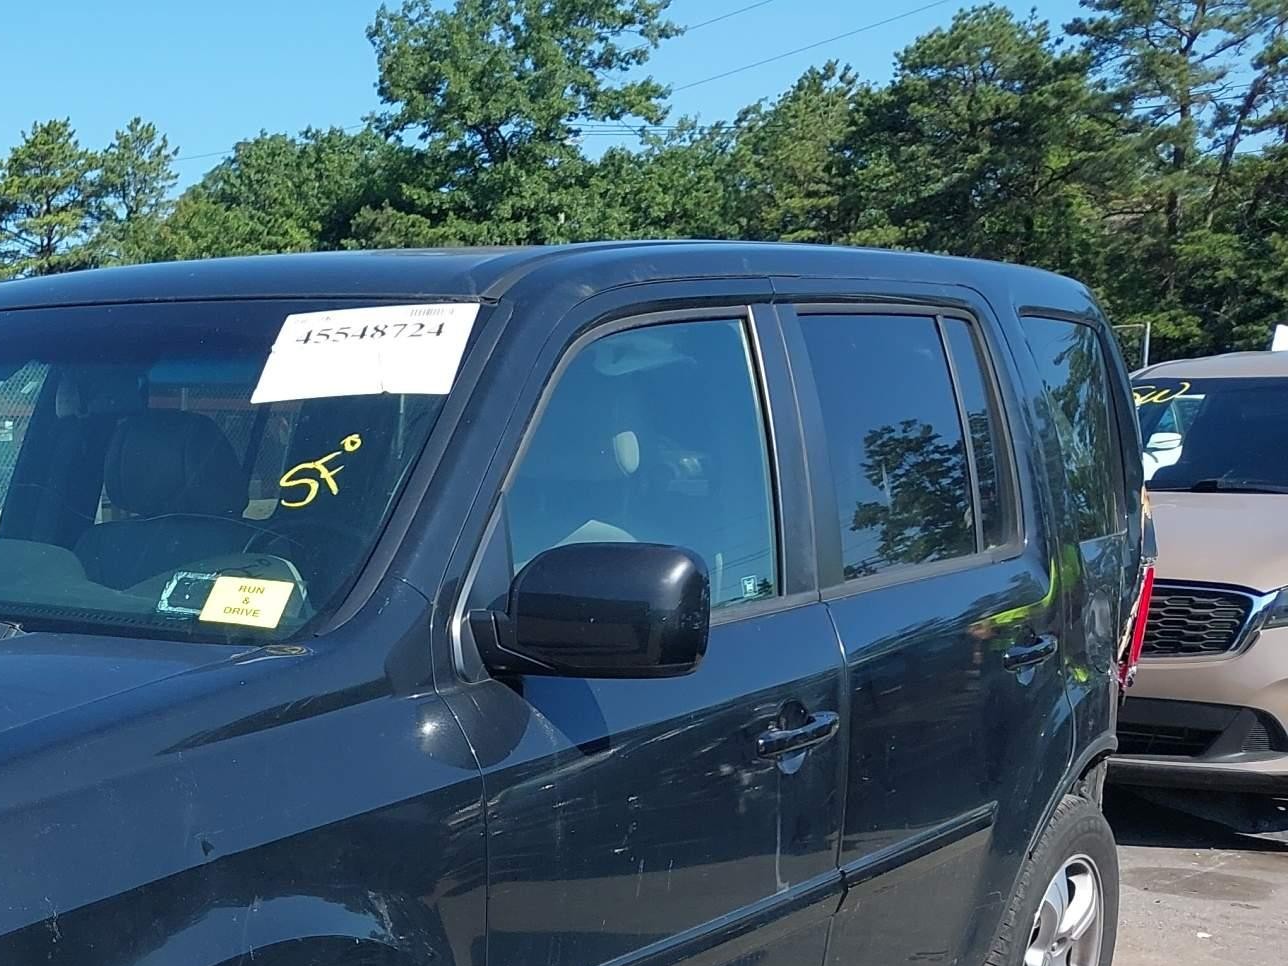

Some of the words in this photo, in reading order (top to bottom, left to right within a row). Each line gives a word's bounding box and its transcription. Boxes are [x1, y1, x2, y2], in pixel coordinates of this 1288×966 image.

[296, 322, 446, 345] 45548724
[238, 585, 266, 595] RUN
[242, 597, 250, 605] &
[223, 606, 262, 618] DRIVE
